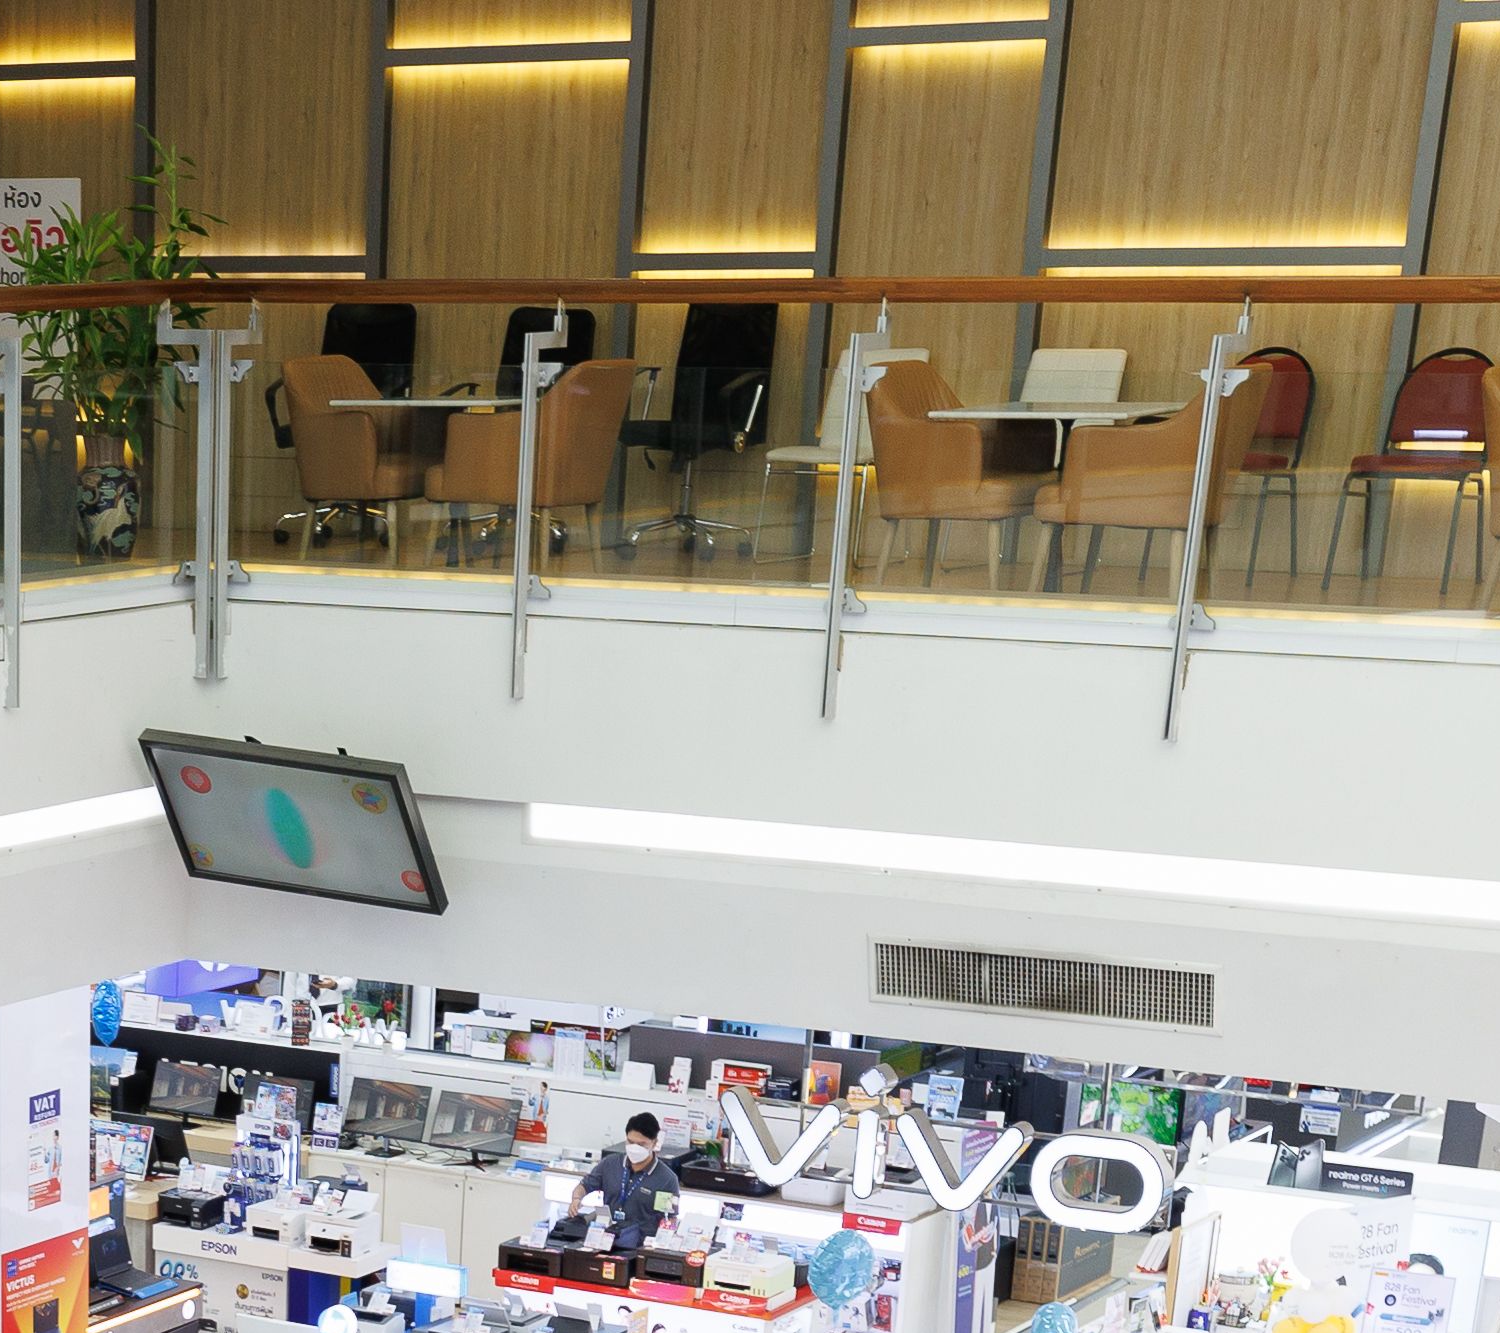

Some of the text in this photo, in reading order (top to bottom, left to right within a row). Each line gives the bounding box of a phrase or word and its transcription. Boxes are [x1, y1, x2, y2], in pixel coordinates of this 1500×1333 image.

[3, 183, 42, 210] ห้อง
[33, 1094, 56, 1112] VAT
[33, 1109, 57, 1122] REFUND
[719, 1063, 1173, 1234] vivo
[1329, 1170, 1359, 1183] realme
[1380, 1176, 1405, 1189] Series
[857, 1216, 886, 1228] Canon
[201, 1240, 237, 1256] EPSON
[1359, 1239, 1398, 1259] estival
[5, 1275, 35, 1292] VICTUS
[511, 1274, 541, 1286] Canon
[720, 1292, 751, 1305] Canon
